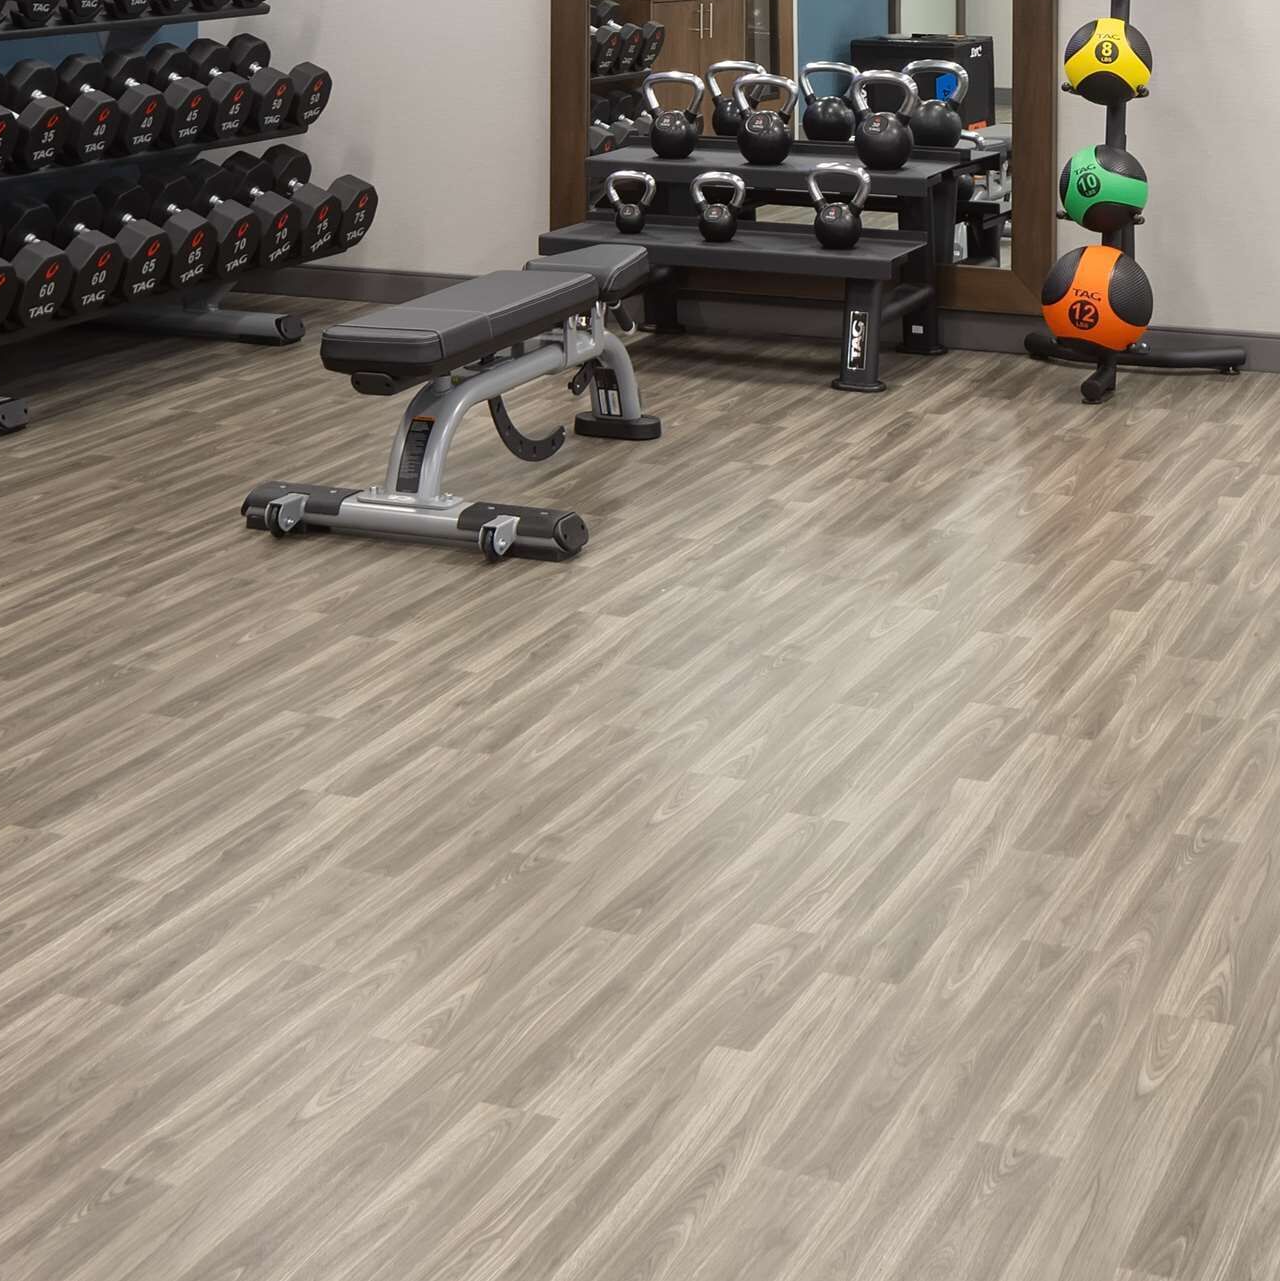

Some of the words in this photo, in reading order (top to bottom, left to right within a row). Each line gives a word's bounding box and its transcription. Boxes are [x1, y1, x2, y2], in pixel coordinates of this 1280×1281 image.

[32, 2, 50, 13] TAG
[81, 0, 99, 8] TAG
[1102, 42, 1112, 56] 8
[271, 98, 283, 110] 50
[309, 92, 321, 105] 50
[186, 109, 199, 122] 45
[228, 103, 241, 115] 45
[303, 106, 322, 121] TAG
[140, 116, 153, 129] 40
[221, 119, 240, 131] TAG
[264, 114, 281, 125] TAG
[41, 129, 56, 144] 35
[93, 123, 107, 137] 40
[178, 125, 198, 138] TAG
[84, 140, 105, 153] TAG
[132, 133, 153, 145] TAG
[32, 147, 55, 161] TAG
[1079, 175, 1097, 191] 10
[354, 209, 366, 224] 75
[317, 220, 329, 235] 75
[275, 228, 288, 244] 70
[310, 231, 332, 253] TAG
[346, 227, 367, 244] TAG
[234, 237, 247, 253] 70
[268, 241, 291, 262] TAG
[187, 246, 203, 264] 65
[141, 258, 157, 275] 65
[226, 254, 248, 272] TAG
[91, 269, 107, 286] 60
[180, 263, 204, 283] TAG
[39, 281, 55, 298] 60
[132, 278, 156, 294] TAG
[81, 289, 105, 305] TAG
[1072, 288, 1101, 302] TAG
[28, 302, 55, 319] TAG
[1072, 303, 1096, 322] 12
[850, 320, 865, 361] TAG
